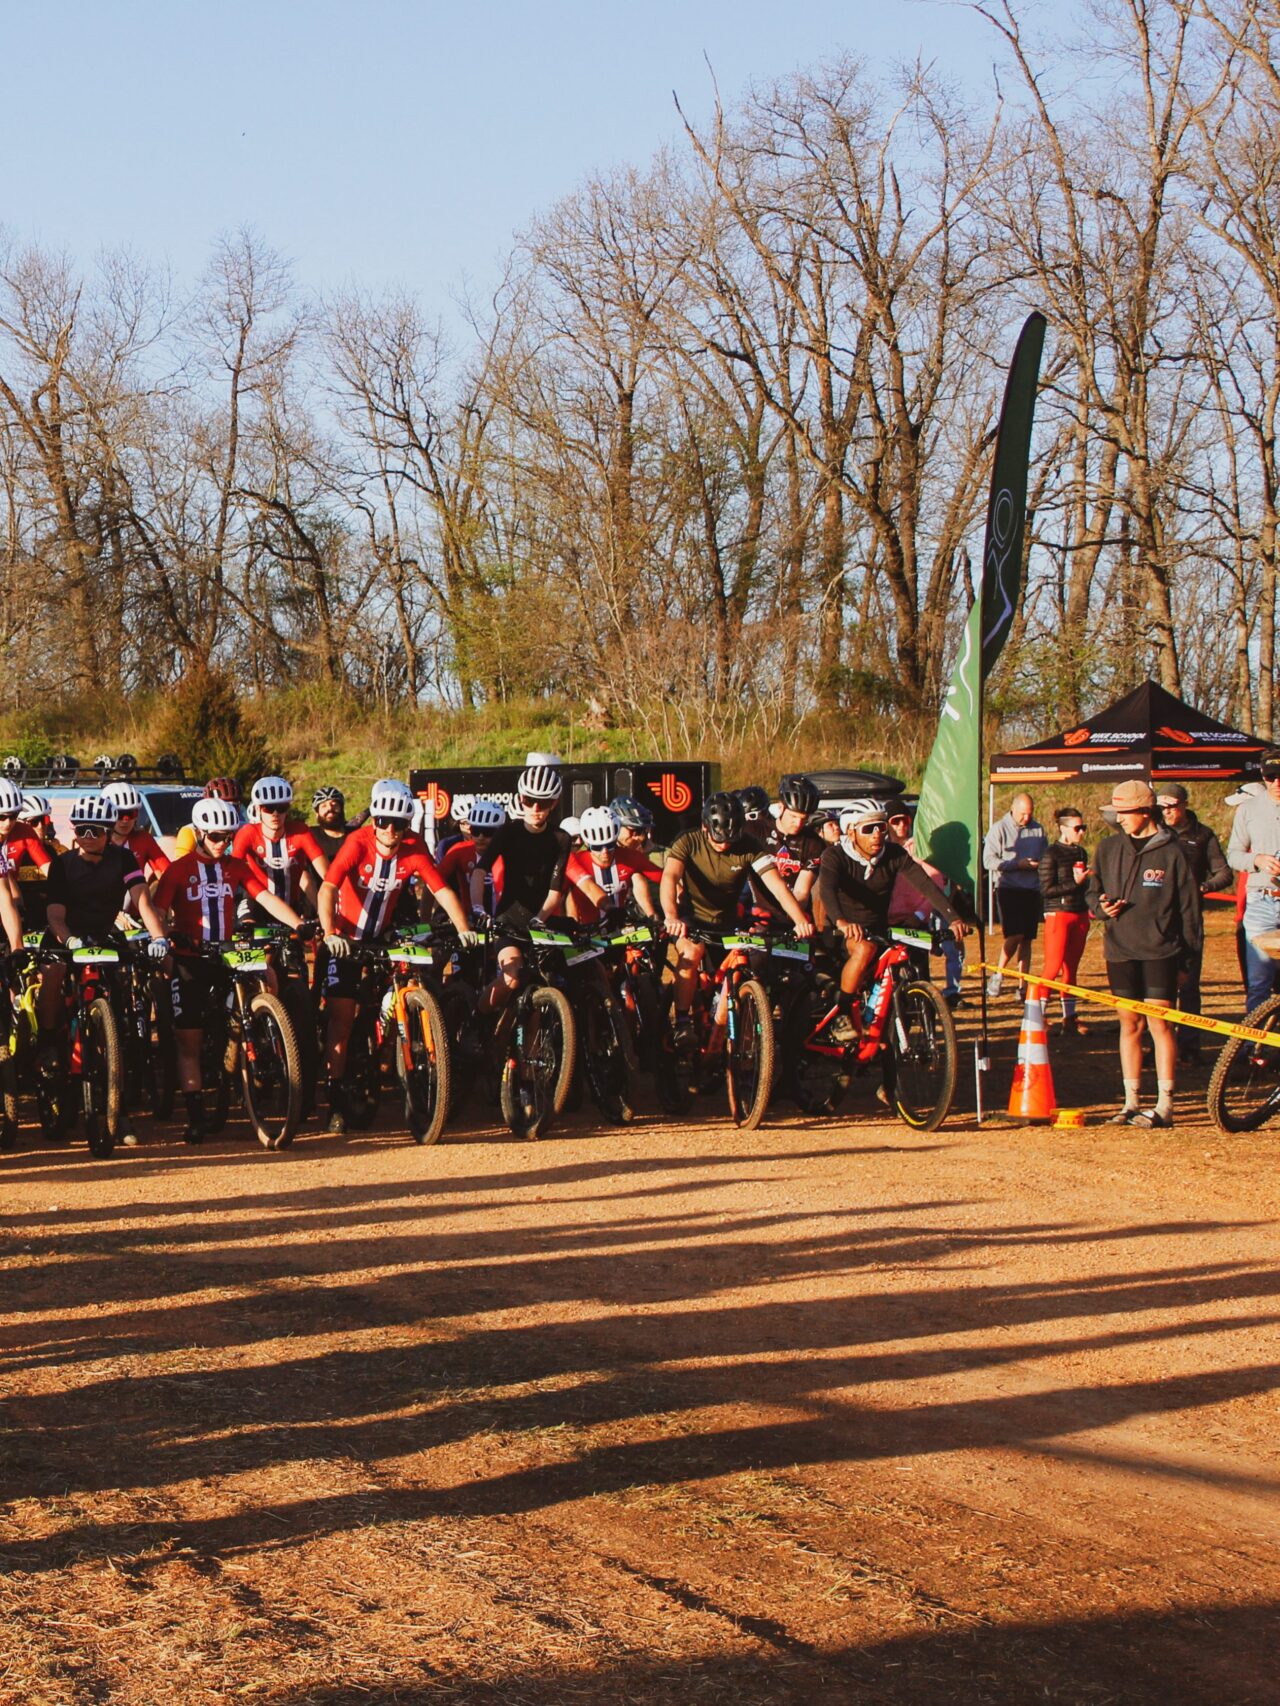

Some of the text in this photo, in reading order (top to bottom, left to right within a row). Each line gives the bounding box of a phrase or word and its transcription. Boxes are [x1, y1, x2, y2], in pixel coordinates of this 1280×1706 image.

[1142, 868, 1165, 882] OZ
[186, 882, 234, 901] USA
[357, 878, 402, 893] USA
[236, 951, 252, 963] 38
[170, 977, 184, 1017] USA
